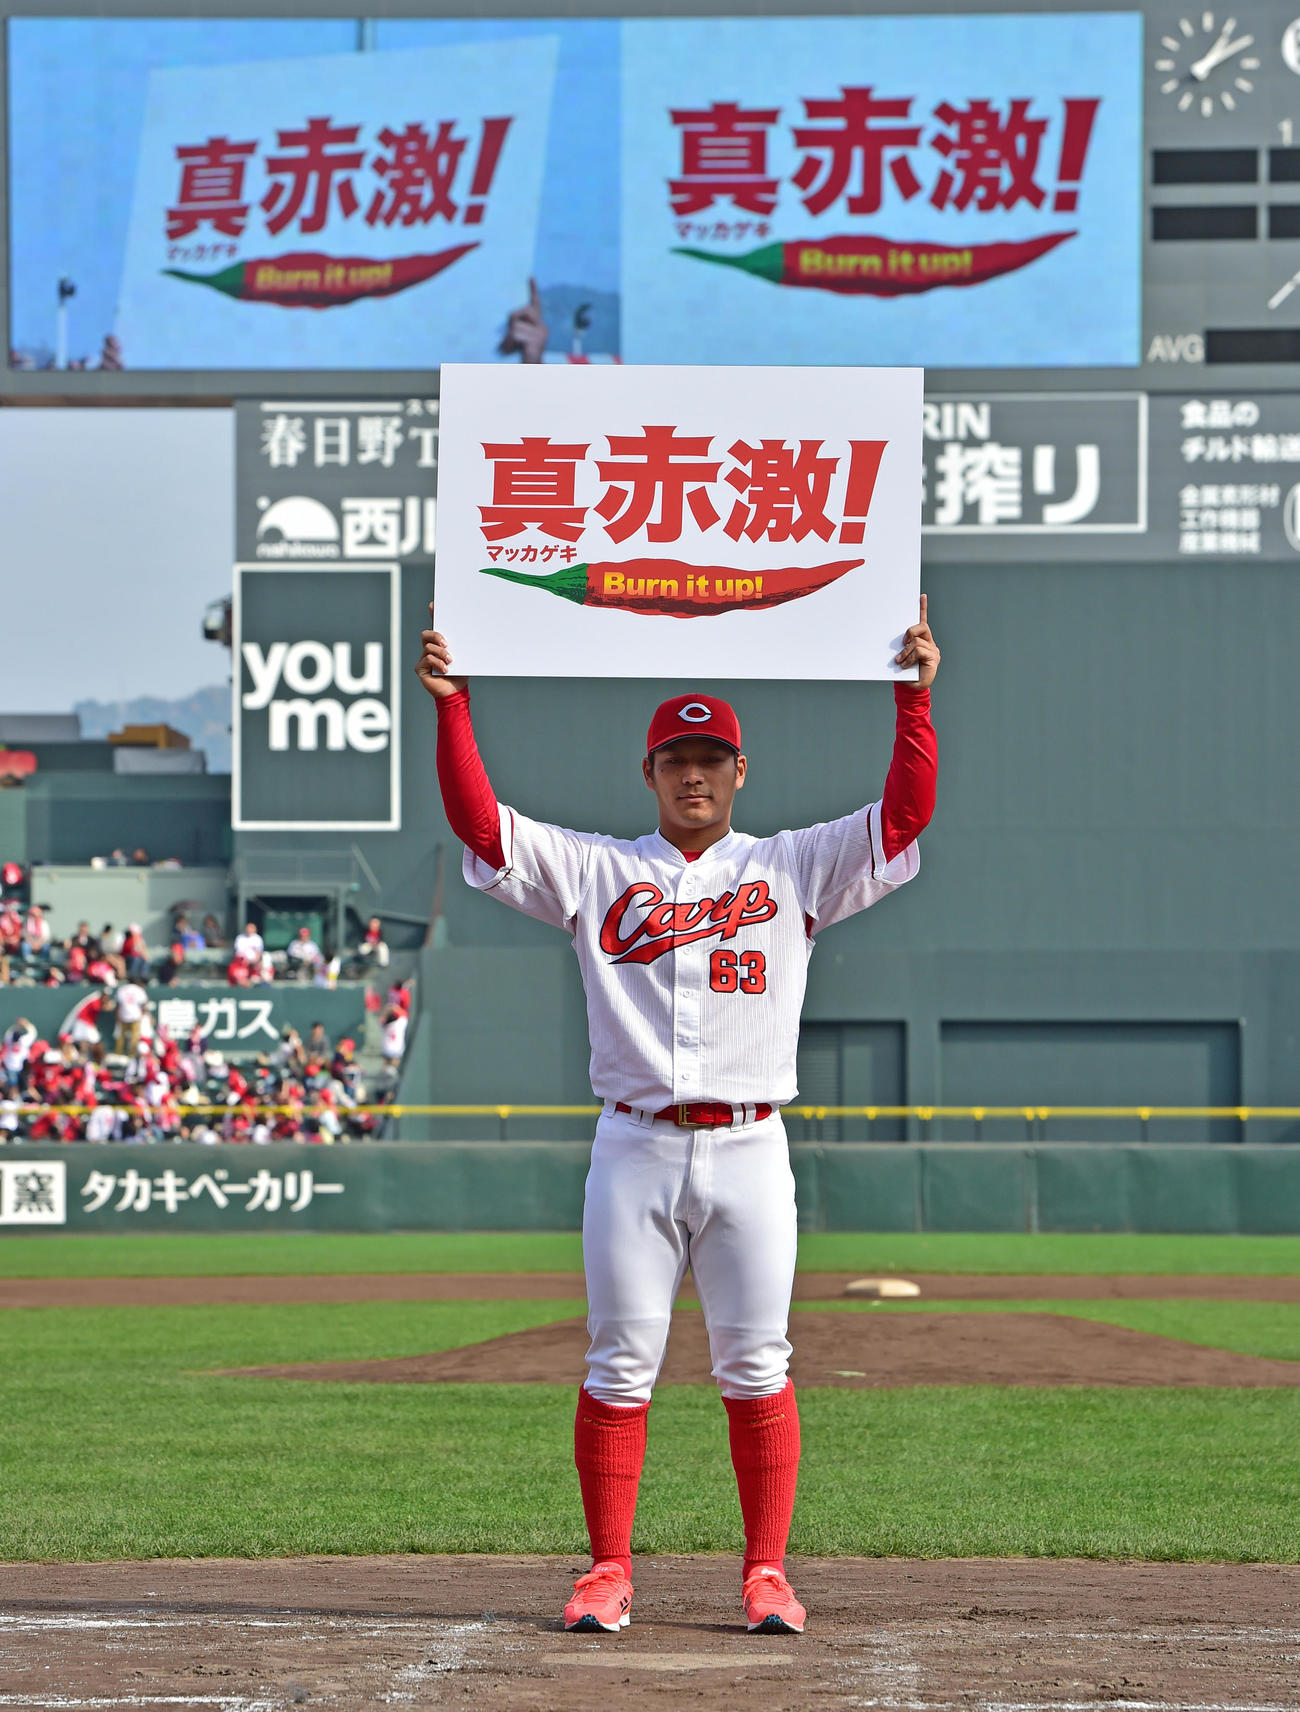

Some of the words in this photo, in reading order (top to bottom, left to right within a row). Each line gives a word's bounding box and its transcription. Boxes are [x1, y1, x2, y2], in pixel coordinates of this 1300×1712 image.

[666, 85, 1103, 216] 真赤激!
[1278, 118, 1293, 146] 1
[163, 116, 515, 240] 真赤激!
[799, 248, 883, 275] Burn
[888, 248, 914, 275] it
[1148, 333, 1205, 363] AVG
[477, 425, 889, 545] 真赤激!
[922, 442, 1101, 525] 搾り
[486, 544, 578, 563] マッカゲキ
[603, 571, 679, 597] Burn
[686, 574, 710, 598] it
[715, 576, 764, 602] up!
[242, 640, 383, 710] you
[268, 698, 391, 753] me
[600, 880, 778, 965] Carp
[709, 949, 766, 994] 63
[146, 998, 280, 1040] 島ガス
[80, 1169, 345, 1213] タカキベーカリー
